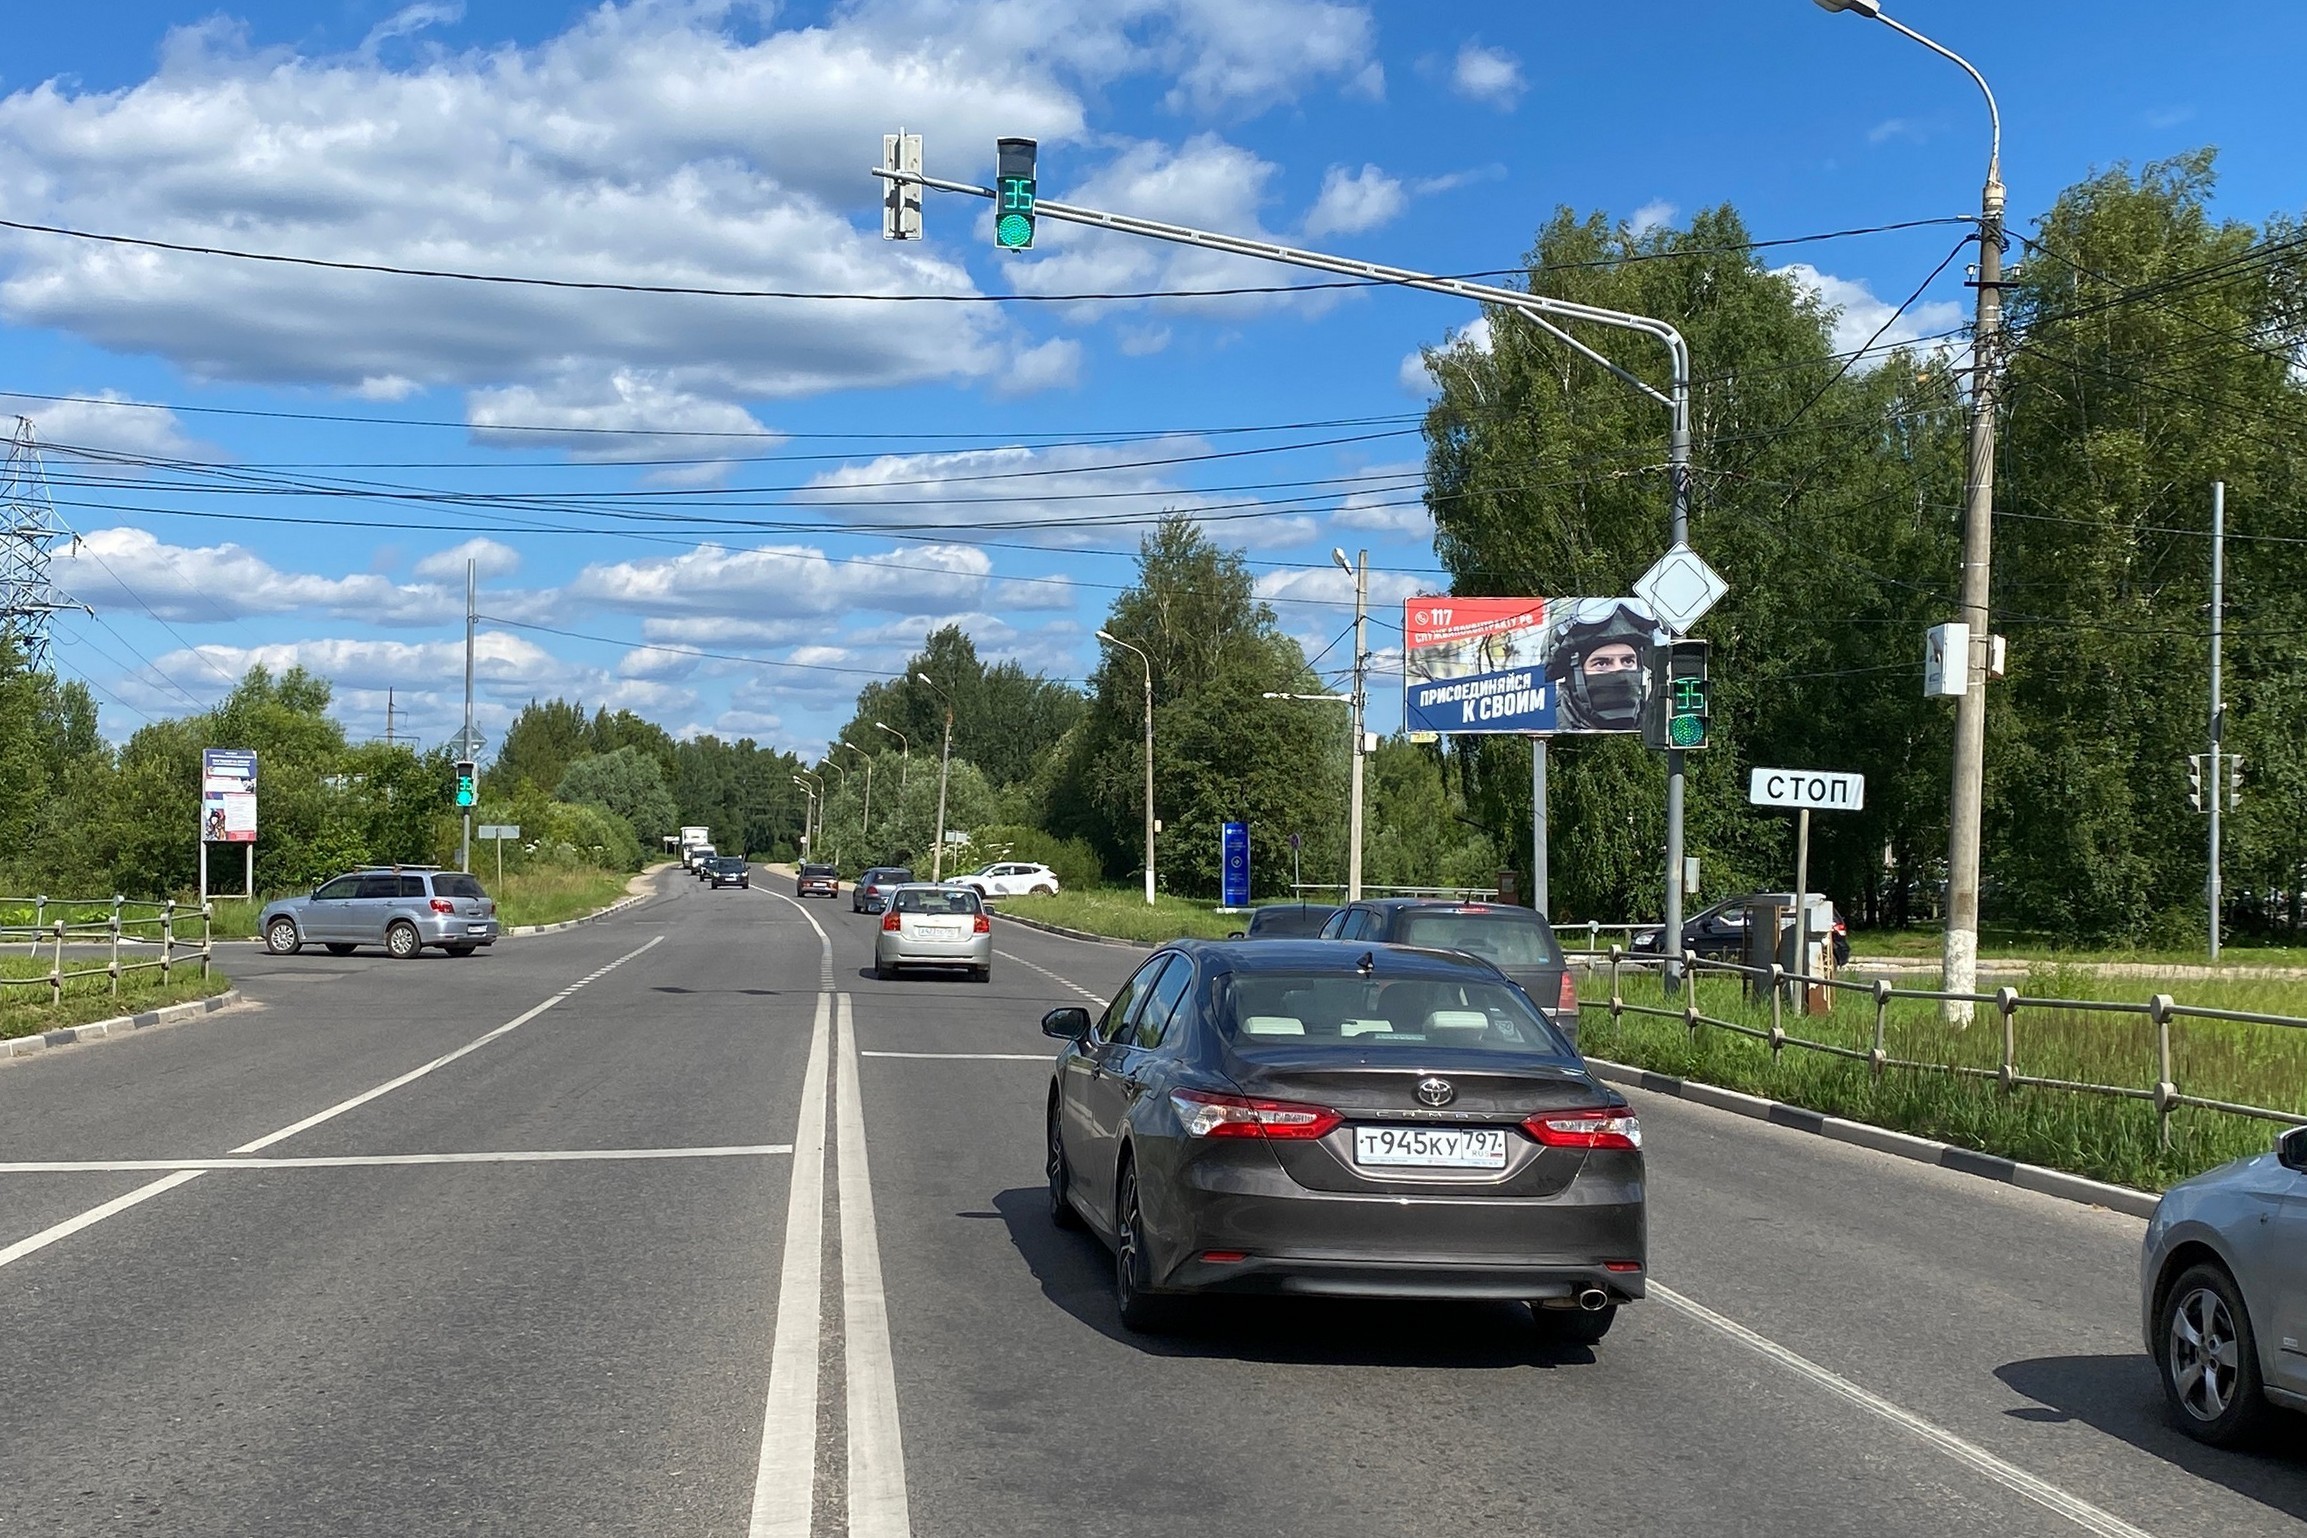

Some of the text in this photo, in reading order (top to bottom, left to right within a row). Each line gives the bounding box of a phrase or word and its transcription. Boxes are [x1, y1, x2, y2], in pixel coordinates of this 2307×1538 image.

[1004, 179, 1032, 209] 35
[1430, 608, 1453, 626] 117
[1420, 672, 1532, 707] ПРИСОЕДИНЯЙСЯ
[1676, 680, 1704, 709] 35
[1462, 687, 1546, 723] К СВОИМ
[1767, 775, 1847, 803] СТОП
